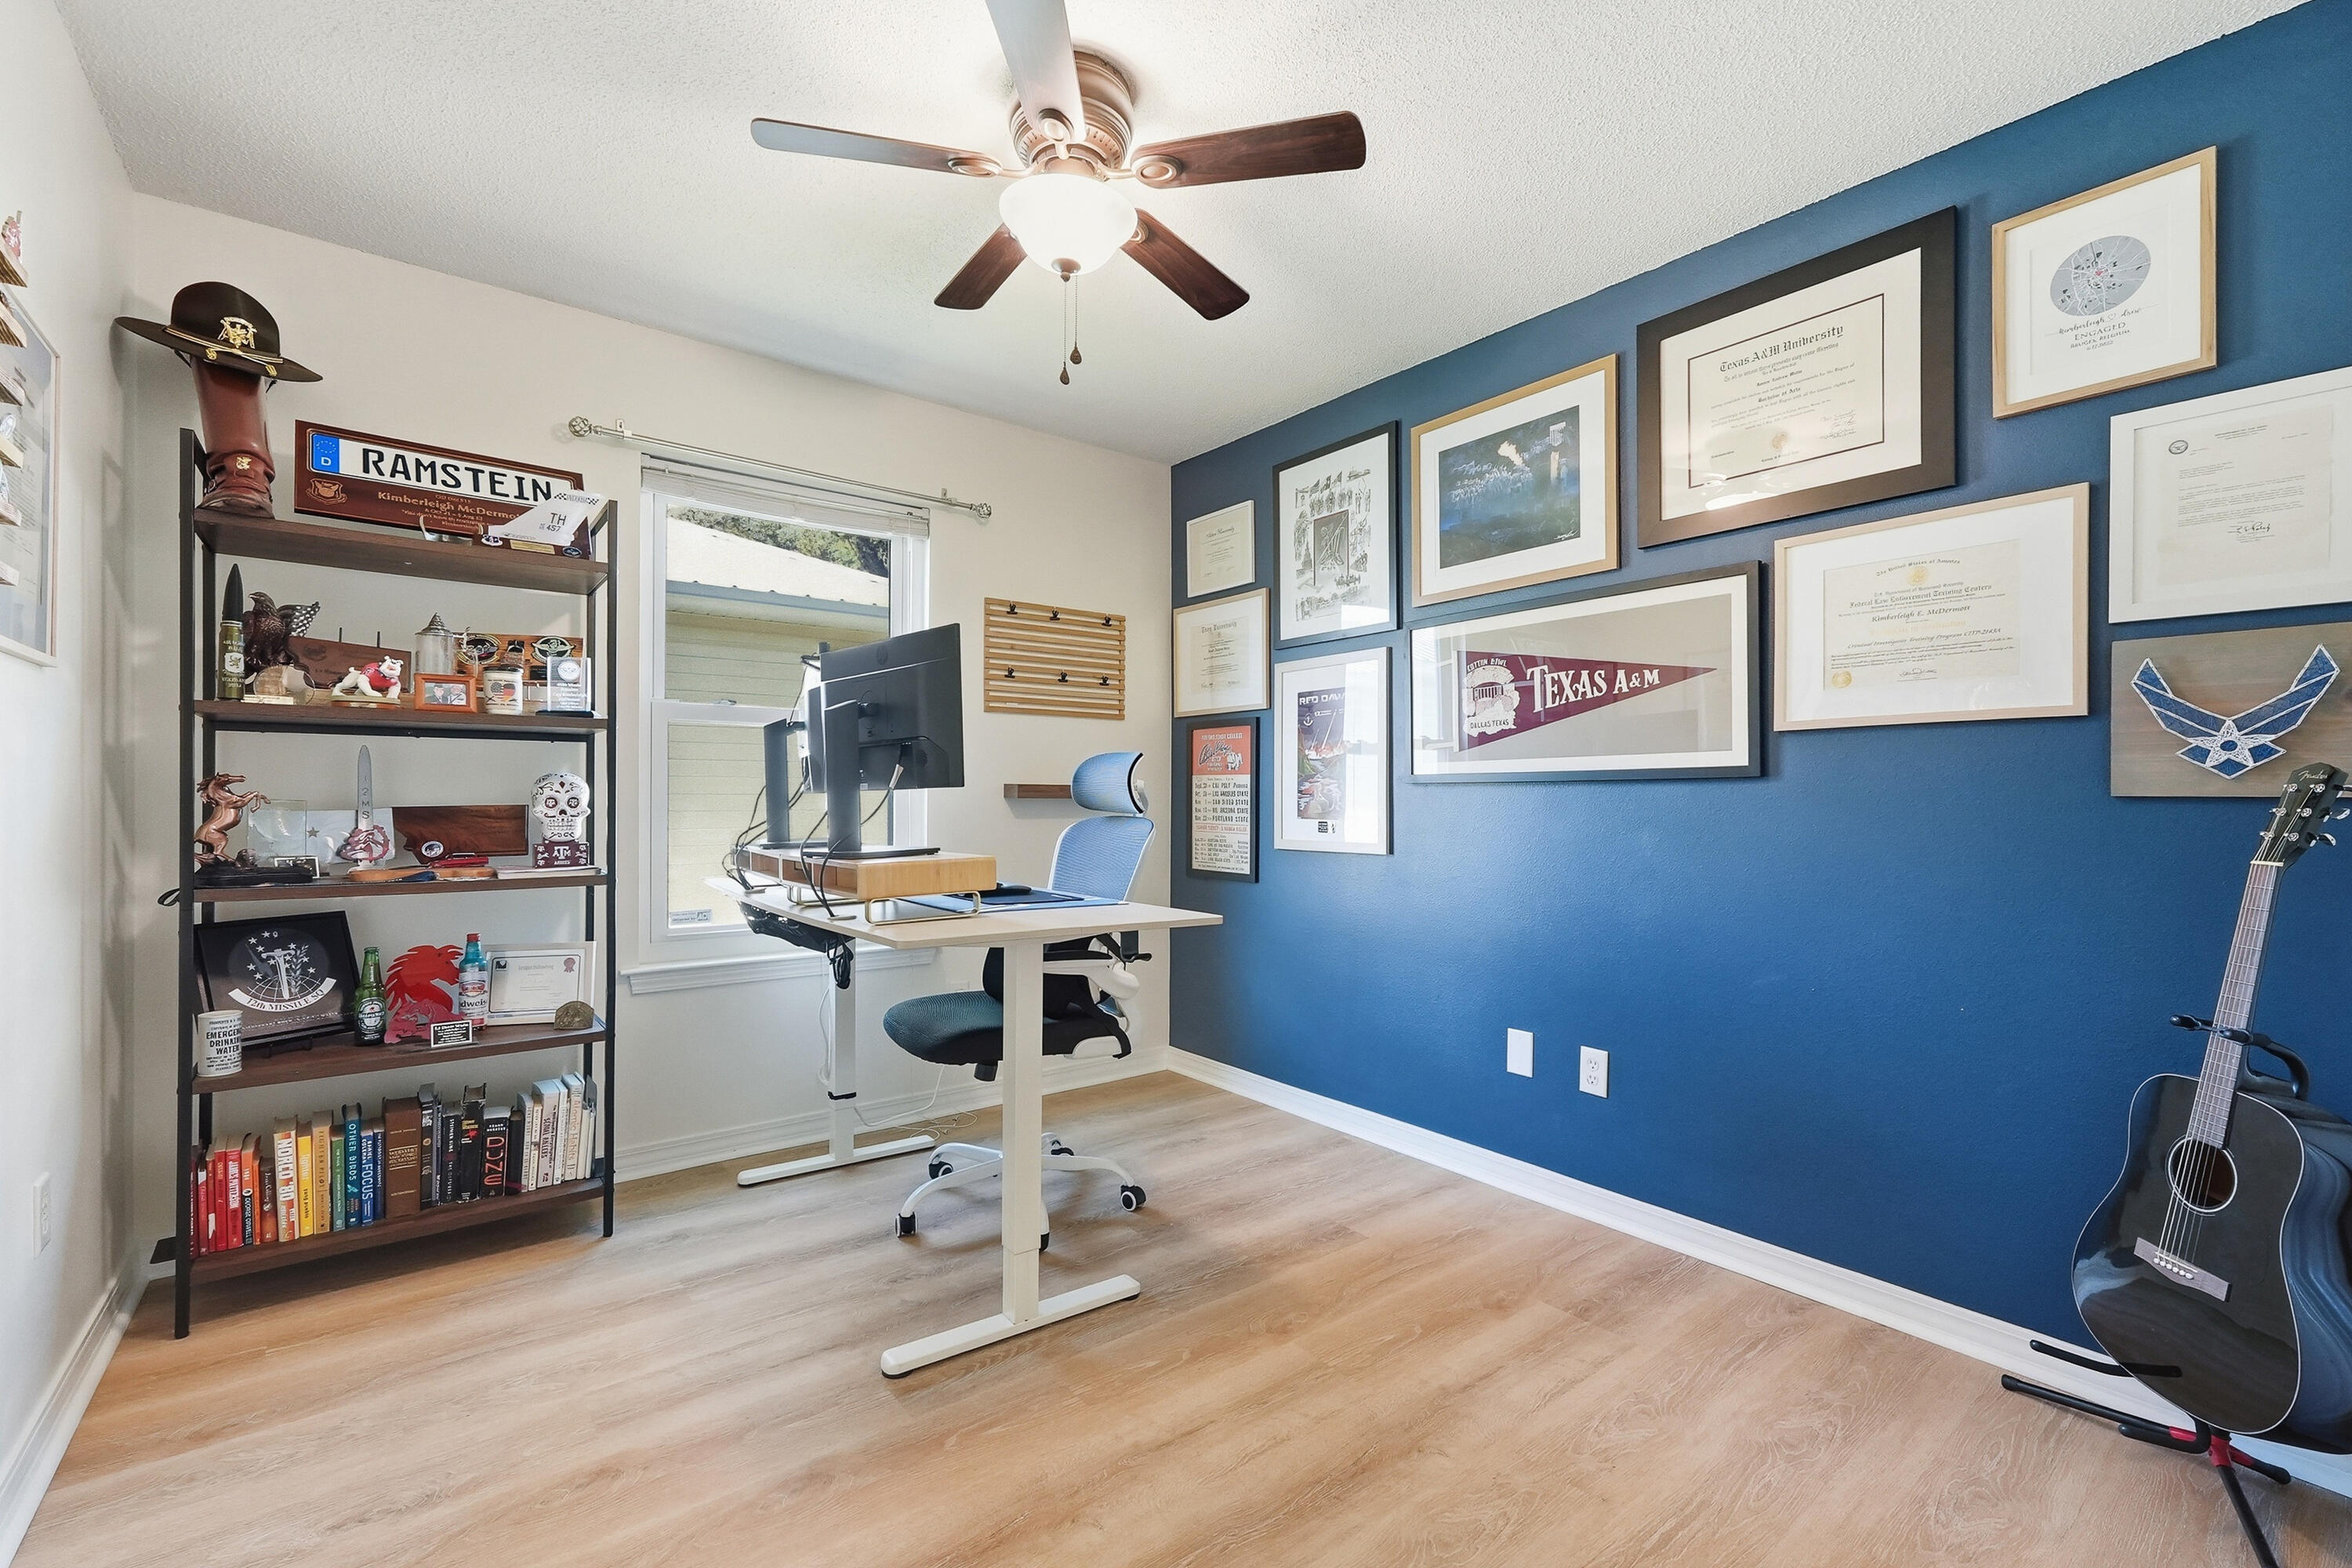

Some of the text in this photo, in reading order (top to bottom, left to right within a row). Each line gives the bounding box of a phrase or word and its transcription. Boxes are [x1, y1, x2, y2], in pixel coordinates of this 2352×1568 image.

[2074, 322, 2125, 340] ENGAGED
[1719, 325, 1843, 372] Texas A&M University
[321, 456, 331, 466] D
[362, 448, 551, 501] RAMSTEIN
[378, 492, 454, 510] Kimberleigh
[550, 513, 566, 525] TH
[1849, 598, 1873, 608] Federal
[1871, 610, 1915, 622] Kimberleigh
[1927, 605, 1970, 615] McDermott
[1526, 665, 1661, 713] TEXAS A&M
[1470, 718, 1509, 729] DALLAS TEXAS
[247, 989, 325, 1011] 12th MISSILE SQ
[348, 1123, 357, 1152] OTHER
[568, 1100, 581, 1161] Atomic Habits
[277, 1138, 295, 1201] NORCO '80
[484, 1136, 505, 1185] DUNE
[228, 1161, 240, 1209] JAMES PATTERSON
[362, 1163, 373, 1200] FOCUS
